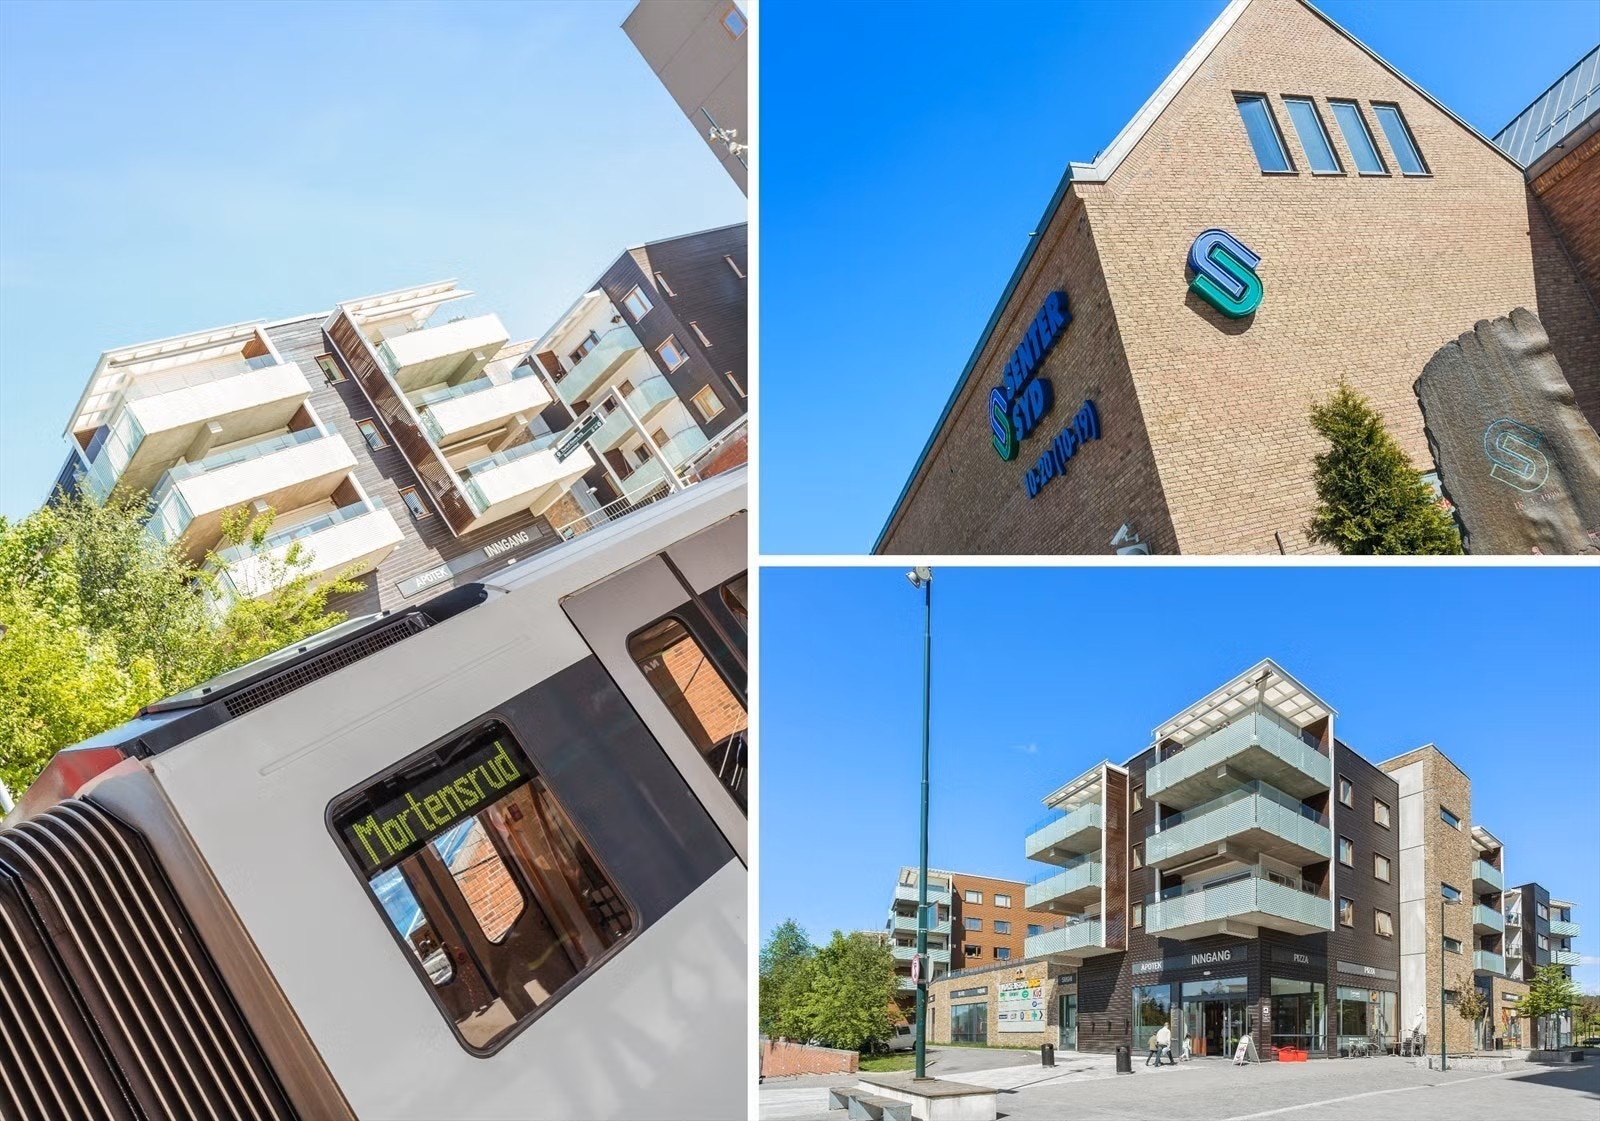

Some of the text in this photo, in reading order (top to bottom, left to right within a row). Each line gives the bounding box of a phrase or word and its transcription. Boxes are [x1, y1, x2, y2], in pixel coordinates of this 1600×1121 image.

[1003, 290, 1072, 399] SENTER
[1013, 377, 1054, 441] SYD
[415, 531, 529, 588] APOTEK INNGANG
[352, 740, 521, 865] Mortensrud
[1141, 950, 1231, 971] APOTEK INNGANG
[1293, 953, 1309, 964] PIZZA
[1364, 966, 1376, 975] PIZZA
